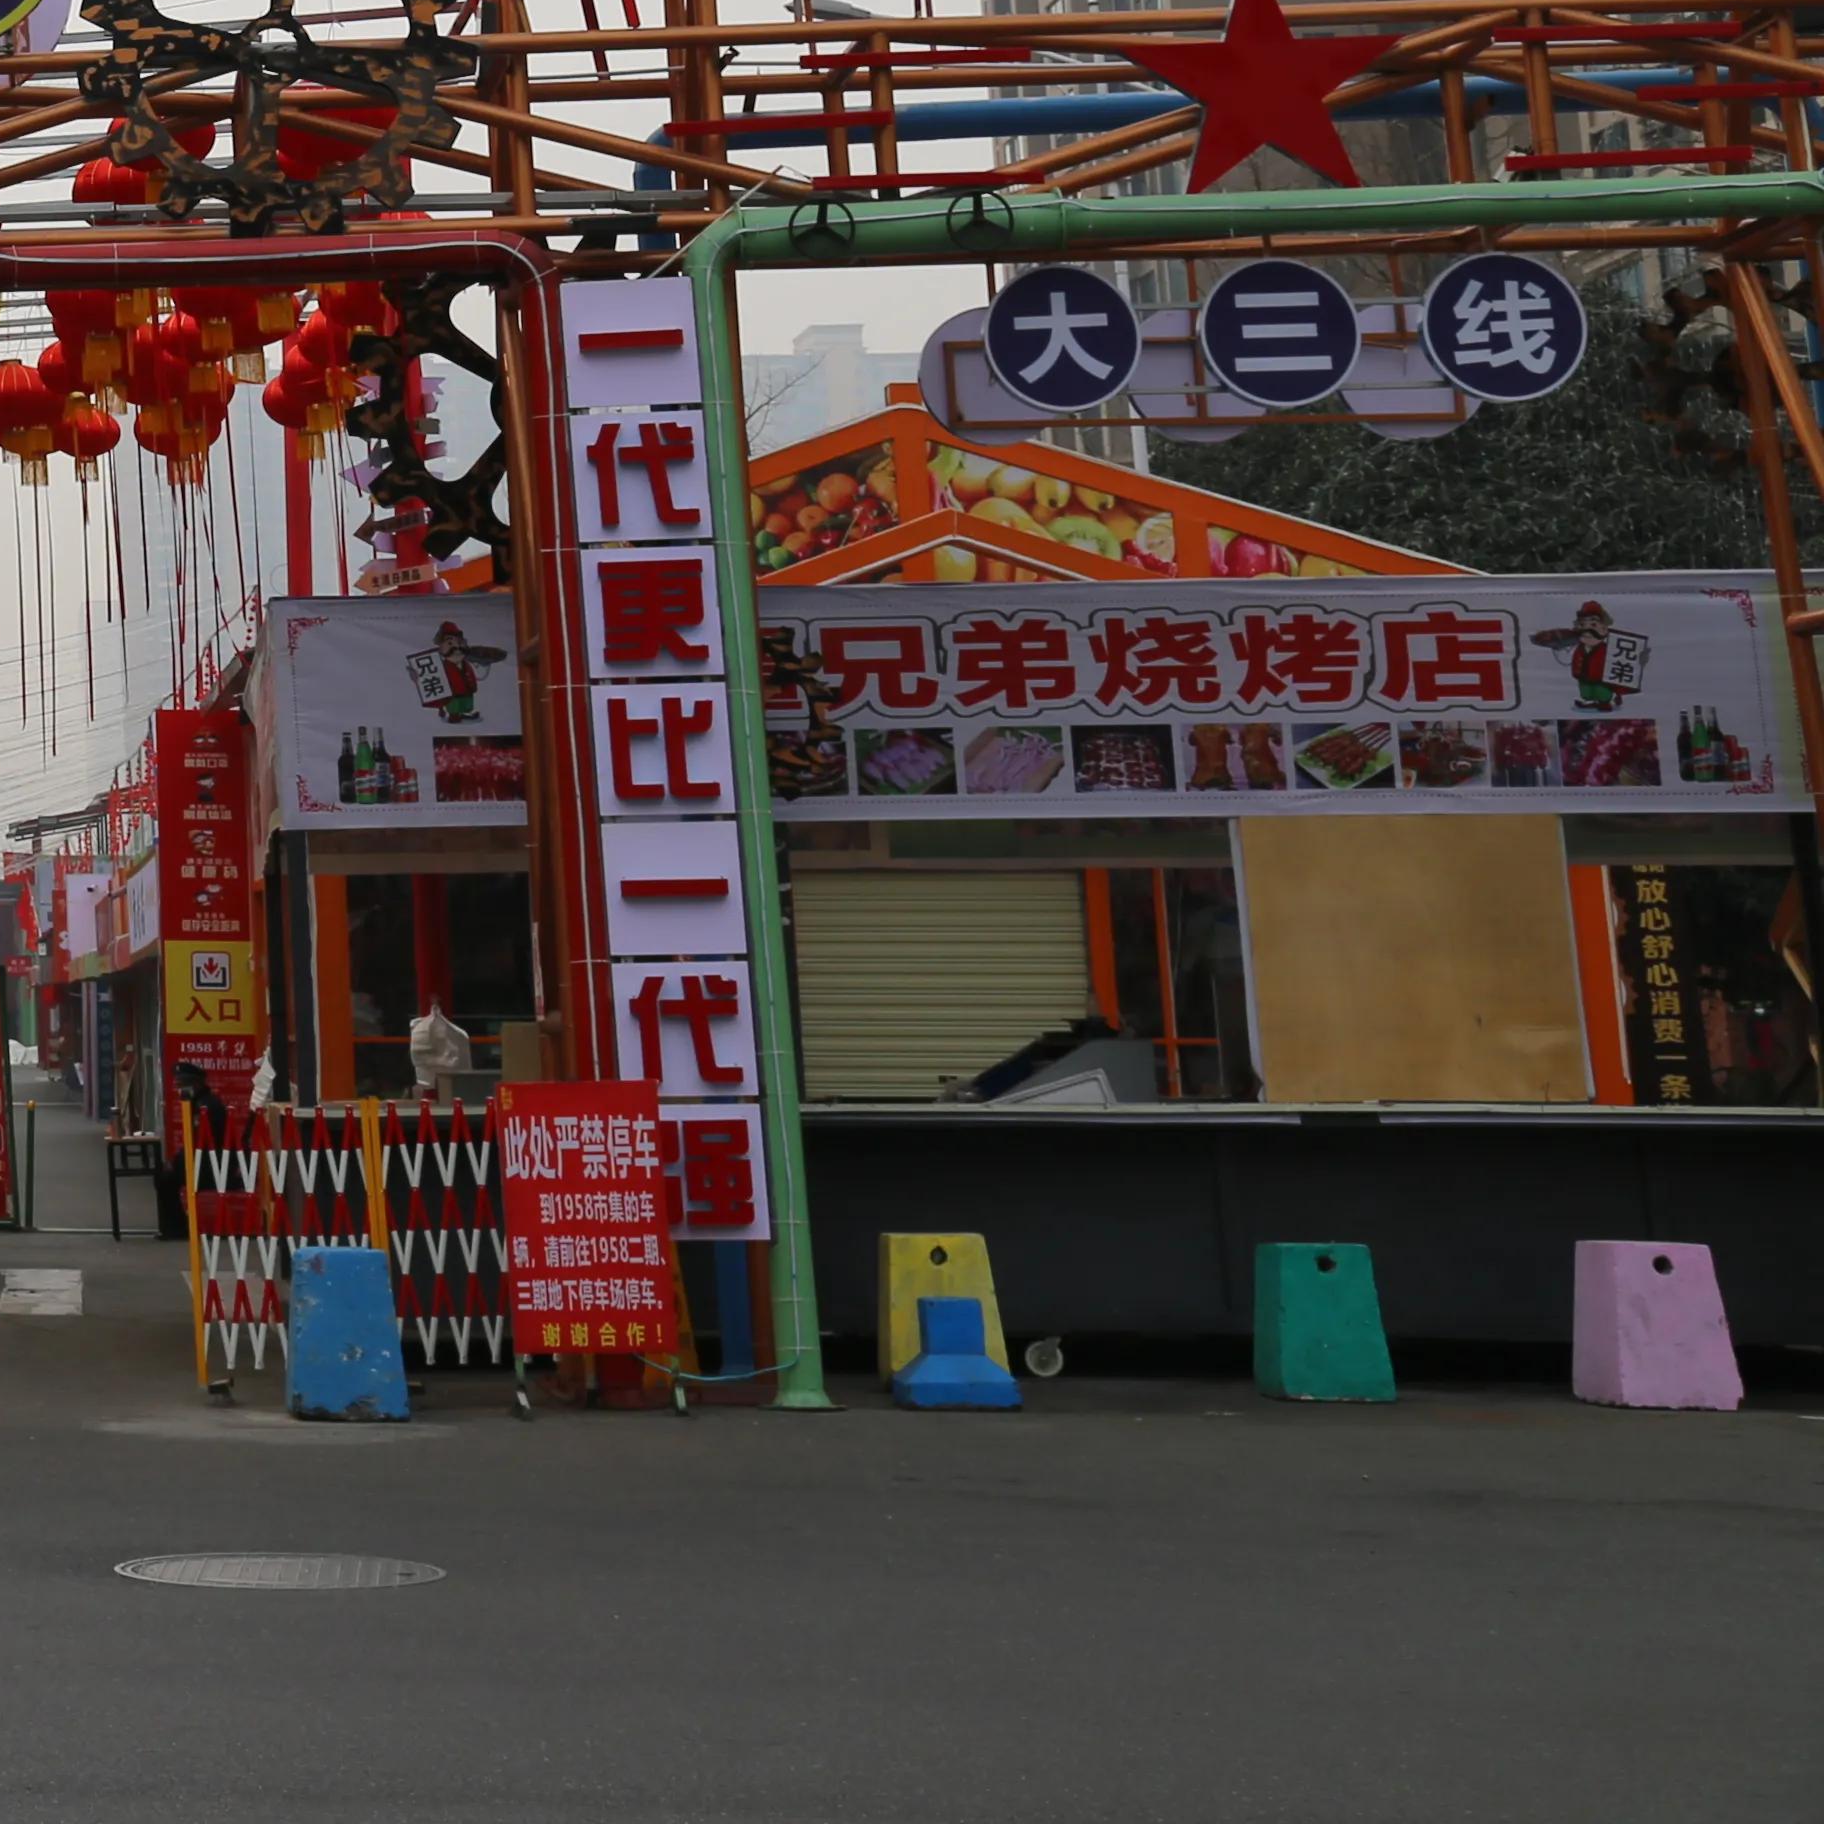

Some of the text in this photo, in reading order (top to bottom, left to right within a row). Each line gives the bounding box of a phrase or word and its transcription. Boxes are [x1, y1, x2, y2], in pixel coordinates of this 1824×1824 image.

[1014, 279, 1556, 383] 大三线
[414, 653, 445, 699] 兄弟
[1610, 637, 1638, 685] 兄弟
[578, 326, 756, 1230] 一代更比一代强
[185, 995, 241, 1023] 入口
[1631, 864, 1693, 1106] 放心舒心消费一条
[504, 1113, 660, 1180] 此处严禁停车
[538, 1191, 656, 1225] 到1958市集的车
[517, 1277, 664, 1311] 三期地下停车场停车。
